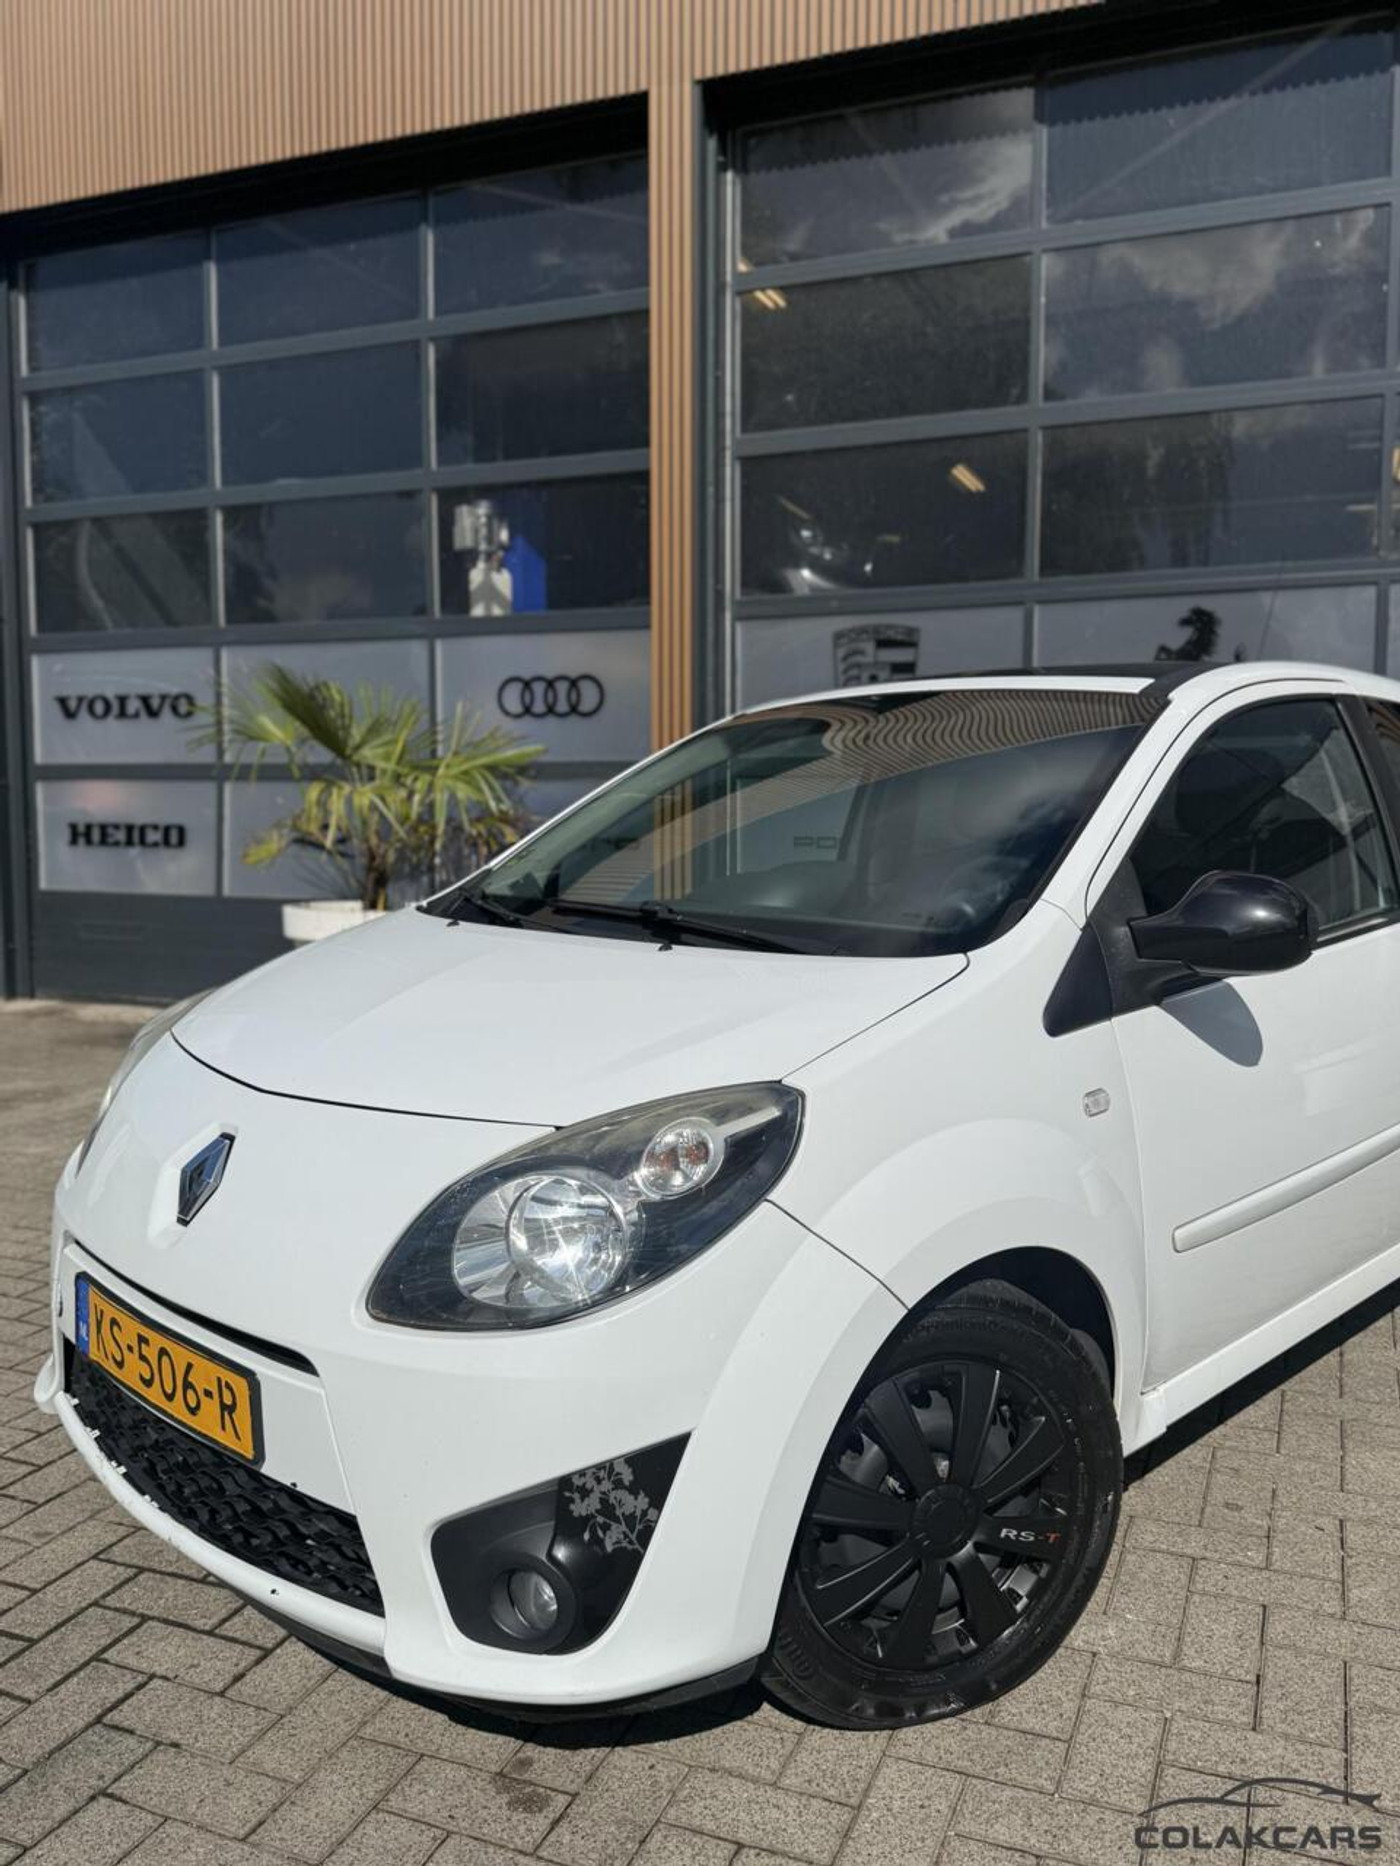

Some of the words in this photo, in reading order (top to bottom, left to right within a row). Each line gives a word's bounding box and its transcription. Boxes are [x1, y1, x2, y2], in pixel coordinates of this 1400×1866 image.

[54, 693, 196, 720] VOLVO
[68, 822, 186, 848] HEICO
[94, 1302, 242, 1442] KS-506-R
[1000, 1528, 1062, 1543] RS-T
